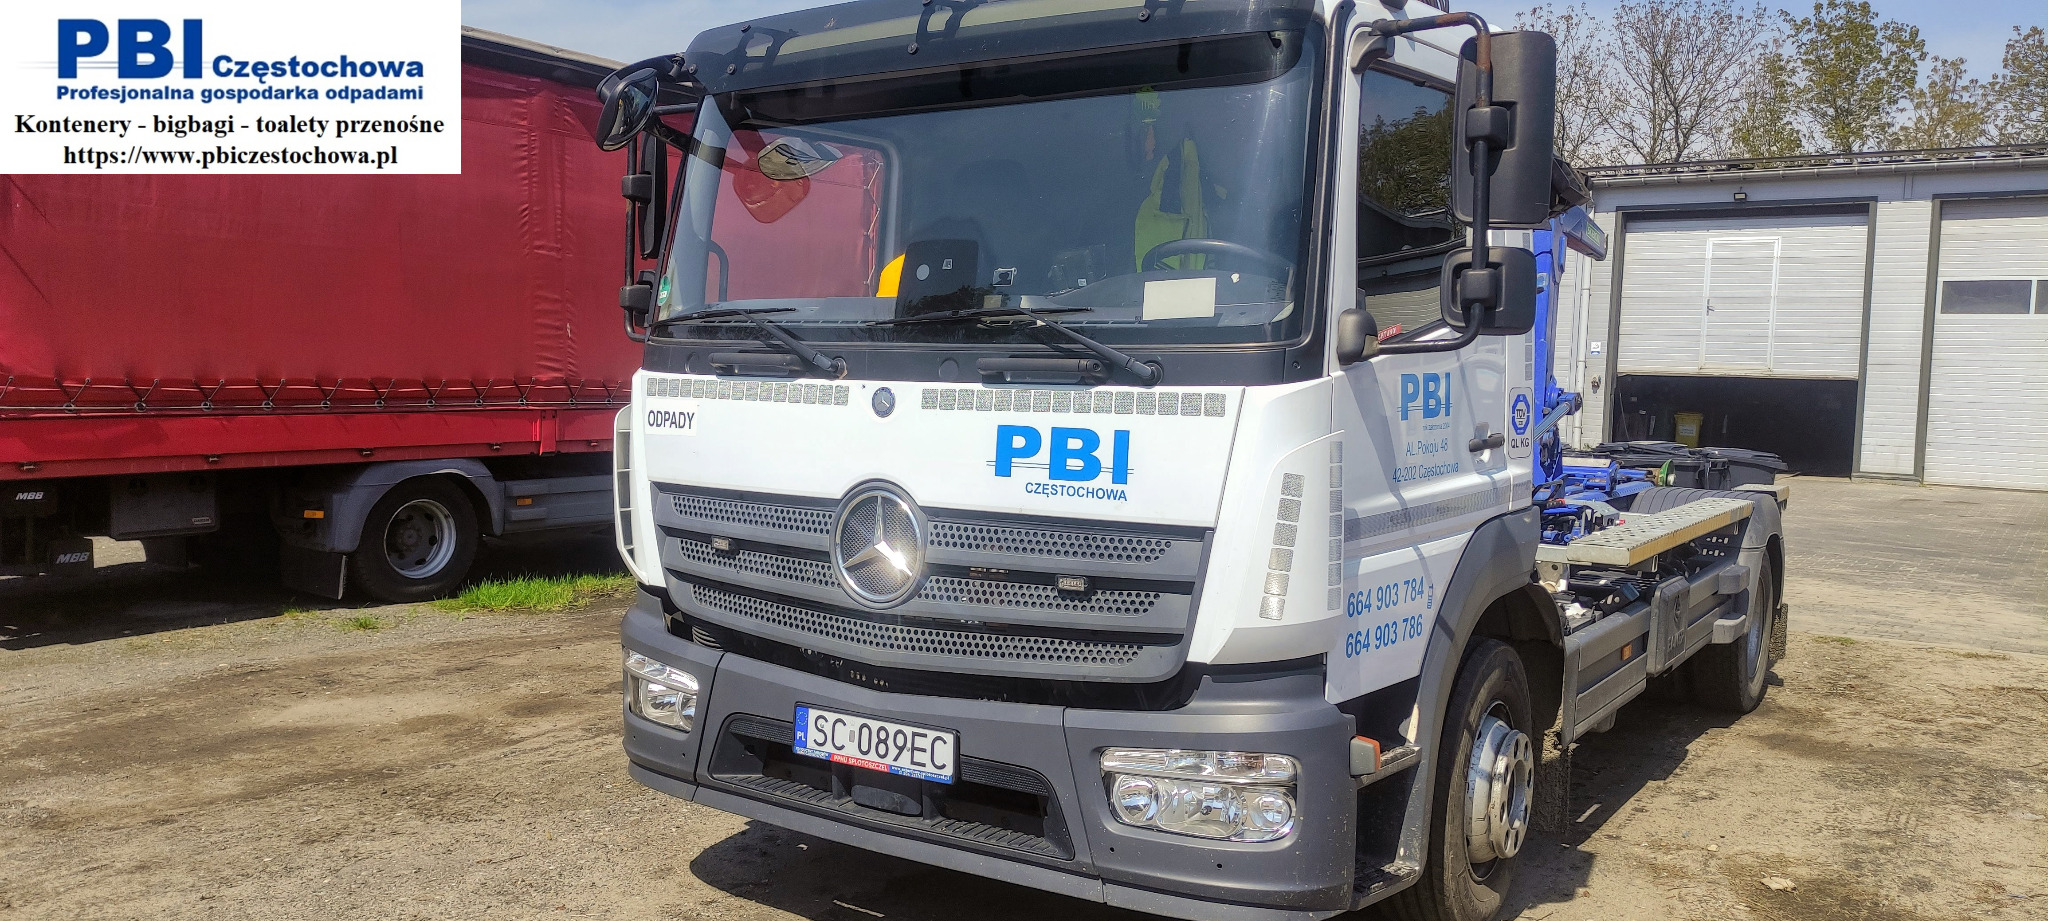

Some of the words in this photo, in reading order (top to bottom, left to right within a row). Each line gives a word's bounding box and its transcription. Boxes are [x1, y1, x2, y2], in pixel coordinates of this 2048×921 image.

[1400, 372, 1451, 421] PBI
[647, 411, 695, 430] ODPADY
[1511, 438, 1519, 448] QL
[1520, 437, 1530, 448] KG
[994, 425, 1131, 484] PBI
[1392, 465, 1417, 483] 42-202
[16, 491, 44, 500] MBB
[1024, 481, 1128, 502] CZĘSTOCHOWA
[56, 552, 90, 564] MBB
[1347, 588, 1372, 618] 664
[1376, 582, 1399, 611] 903
[1403, 576, 1424, 603] 784
[1345, 628, 1371, 659] 664
[1374, 620, 1398, 650] 903
[1402, 613, 1423, 642] 786
[796, 731, 806, 741] PL
[813, 714, 847, 751] SC
[857, 722, 947, 770] 089EC
